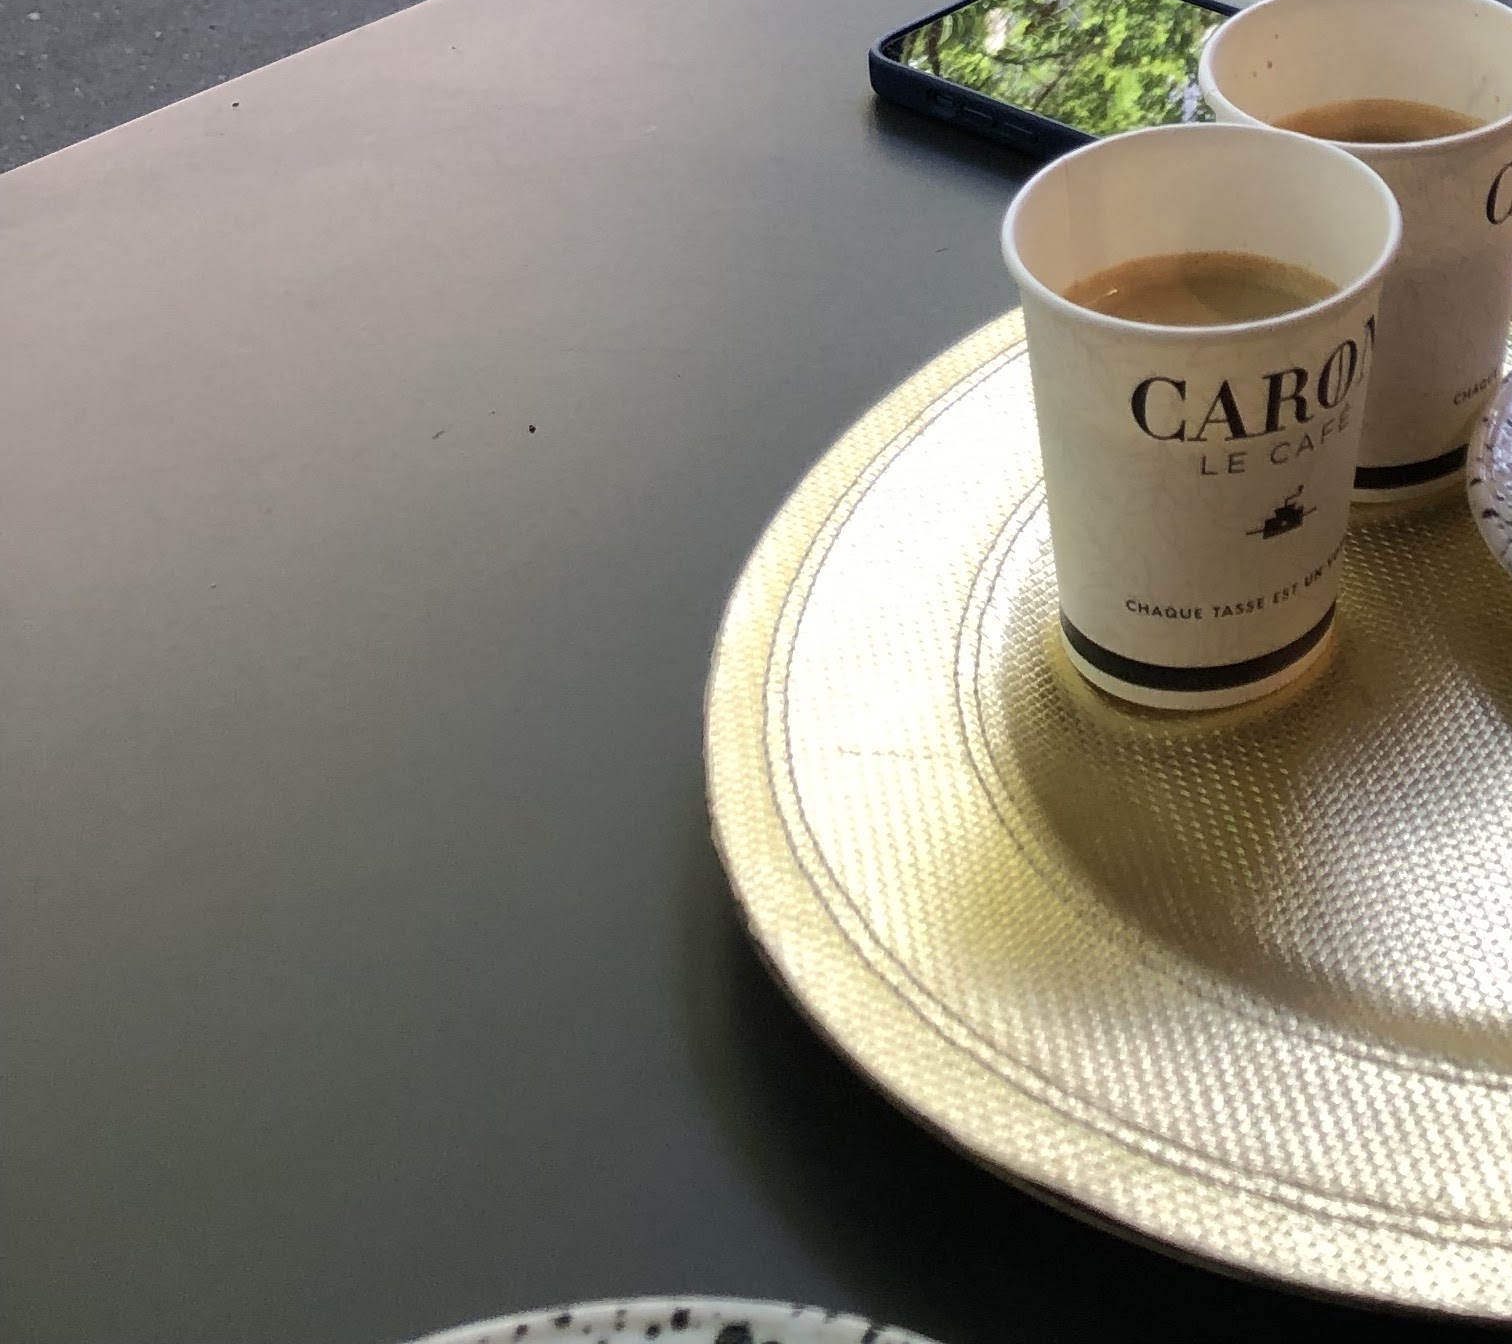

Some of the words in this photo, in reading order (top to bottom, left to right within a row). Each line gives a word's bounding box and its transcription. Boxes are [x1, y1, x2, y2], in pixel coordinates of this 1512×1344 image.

[1453, 366, 1499, 406] CHAQ
[1200, 451, 1249, 477] LE
[1125, 598, 1204, 621] CHAQUE
[1213, 596, 1266, 619] TASSE
[1272, 582, 1299, 605] EST
[1303, 565, 1324, 588] UN
